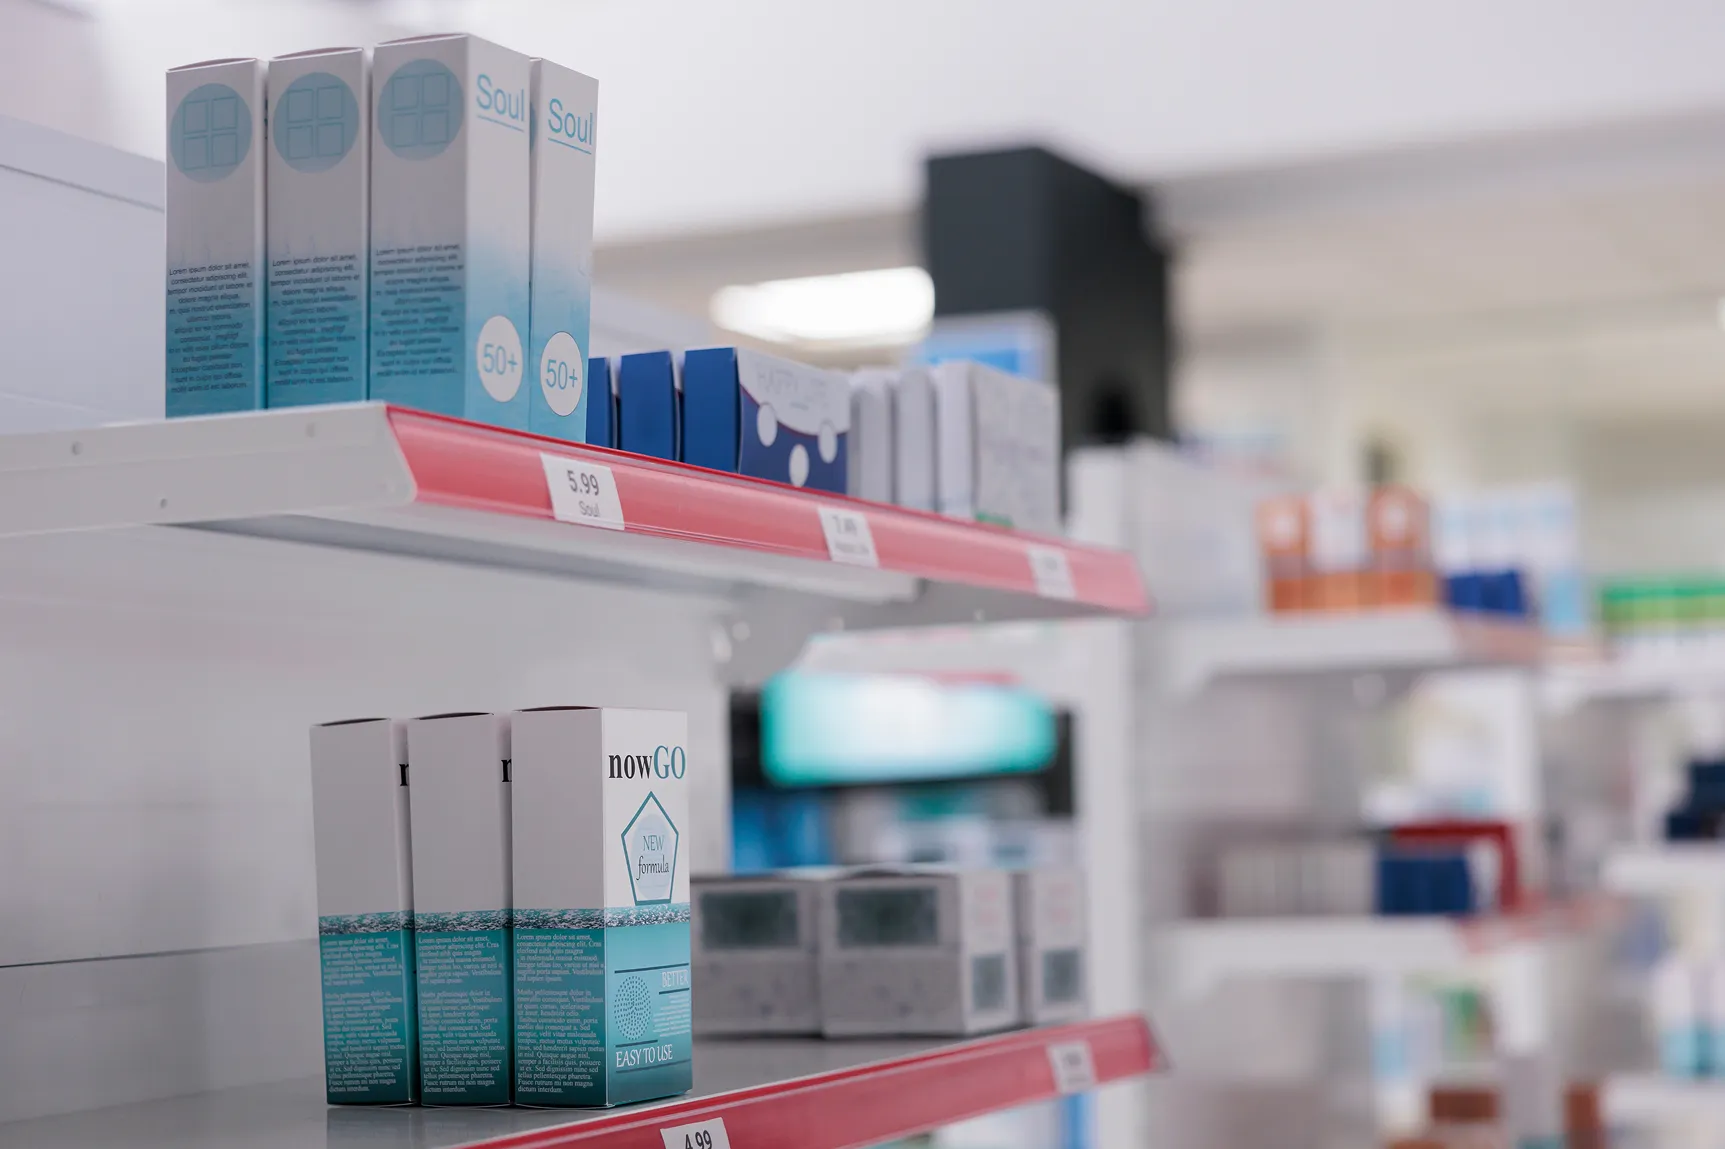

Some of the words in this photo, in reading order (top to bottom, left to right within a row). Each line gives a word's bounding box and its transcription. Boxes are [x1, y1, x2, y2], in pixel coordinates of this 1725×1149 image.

[476, 73, 525, 122] Soul
[547, 98, 594, 146] Soul
[483, 343, 519, 375] 50+
[546, 358, 578, 390] 50+
[567, 469, 600, 496] 5.99
[578, 500, 600, 518] Soul
[608, 745, 686, 780] nowGO
[643, 834, 665, 851] NEW
[636, 854, 670, 881] formula
[662, 970, 688, 988] BETTER
[616, 1049, 642, 1068] EASY
[642, 1047, 656, 1064] TO
[657, 1043, 673, 1060] USE
[685, 1129, 712, 1149] 499
